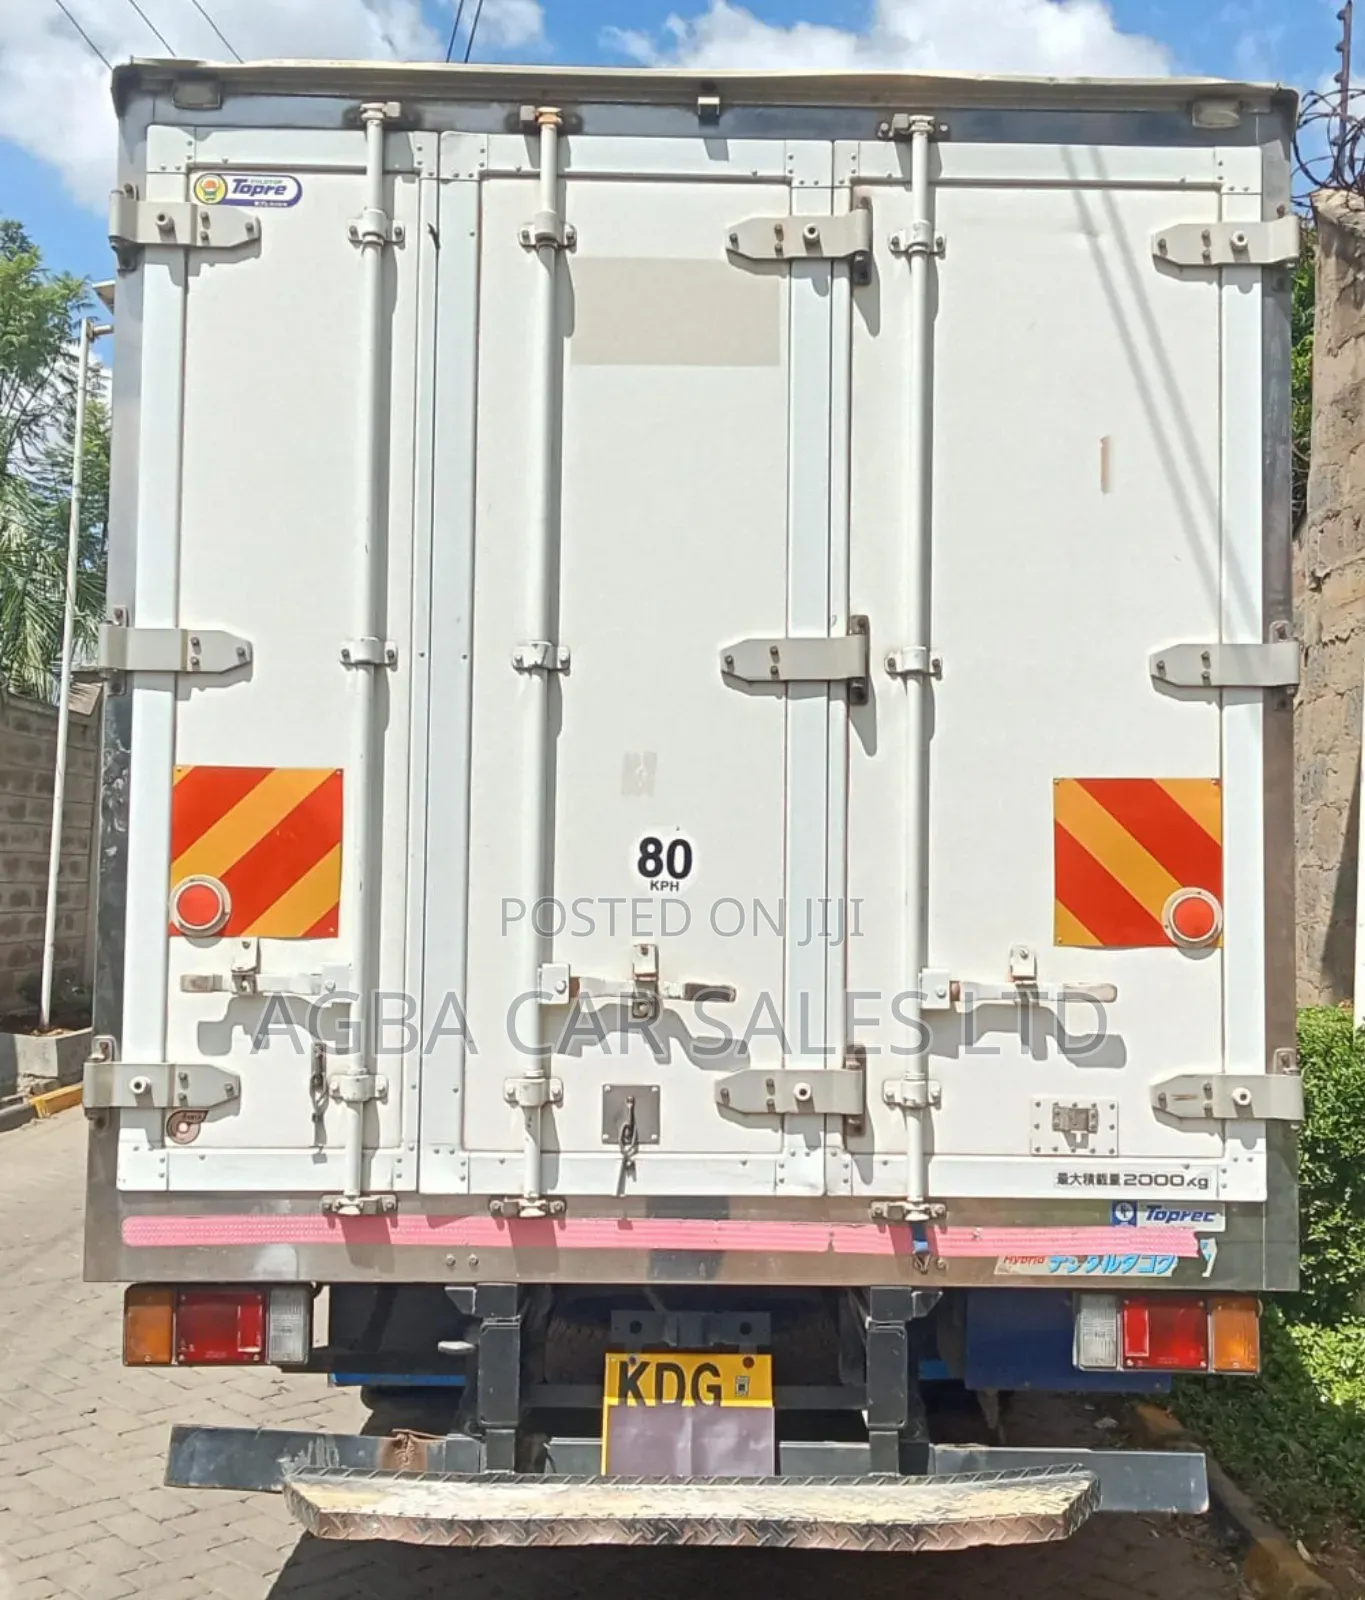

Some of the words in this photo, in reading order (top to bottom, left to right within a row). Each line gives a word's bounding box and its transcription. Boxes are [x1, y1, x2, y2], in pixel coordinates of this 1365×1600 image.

[232, 178, 287, 197] Topre
[637, 837, 693, 880] 80
[650, 880, 680, 892] KPH
[1145, 1204, 1216, 1224] Toprec
[618, 1361, 723, 1407] KDG
